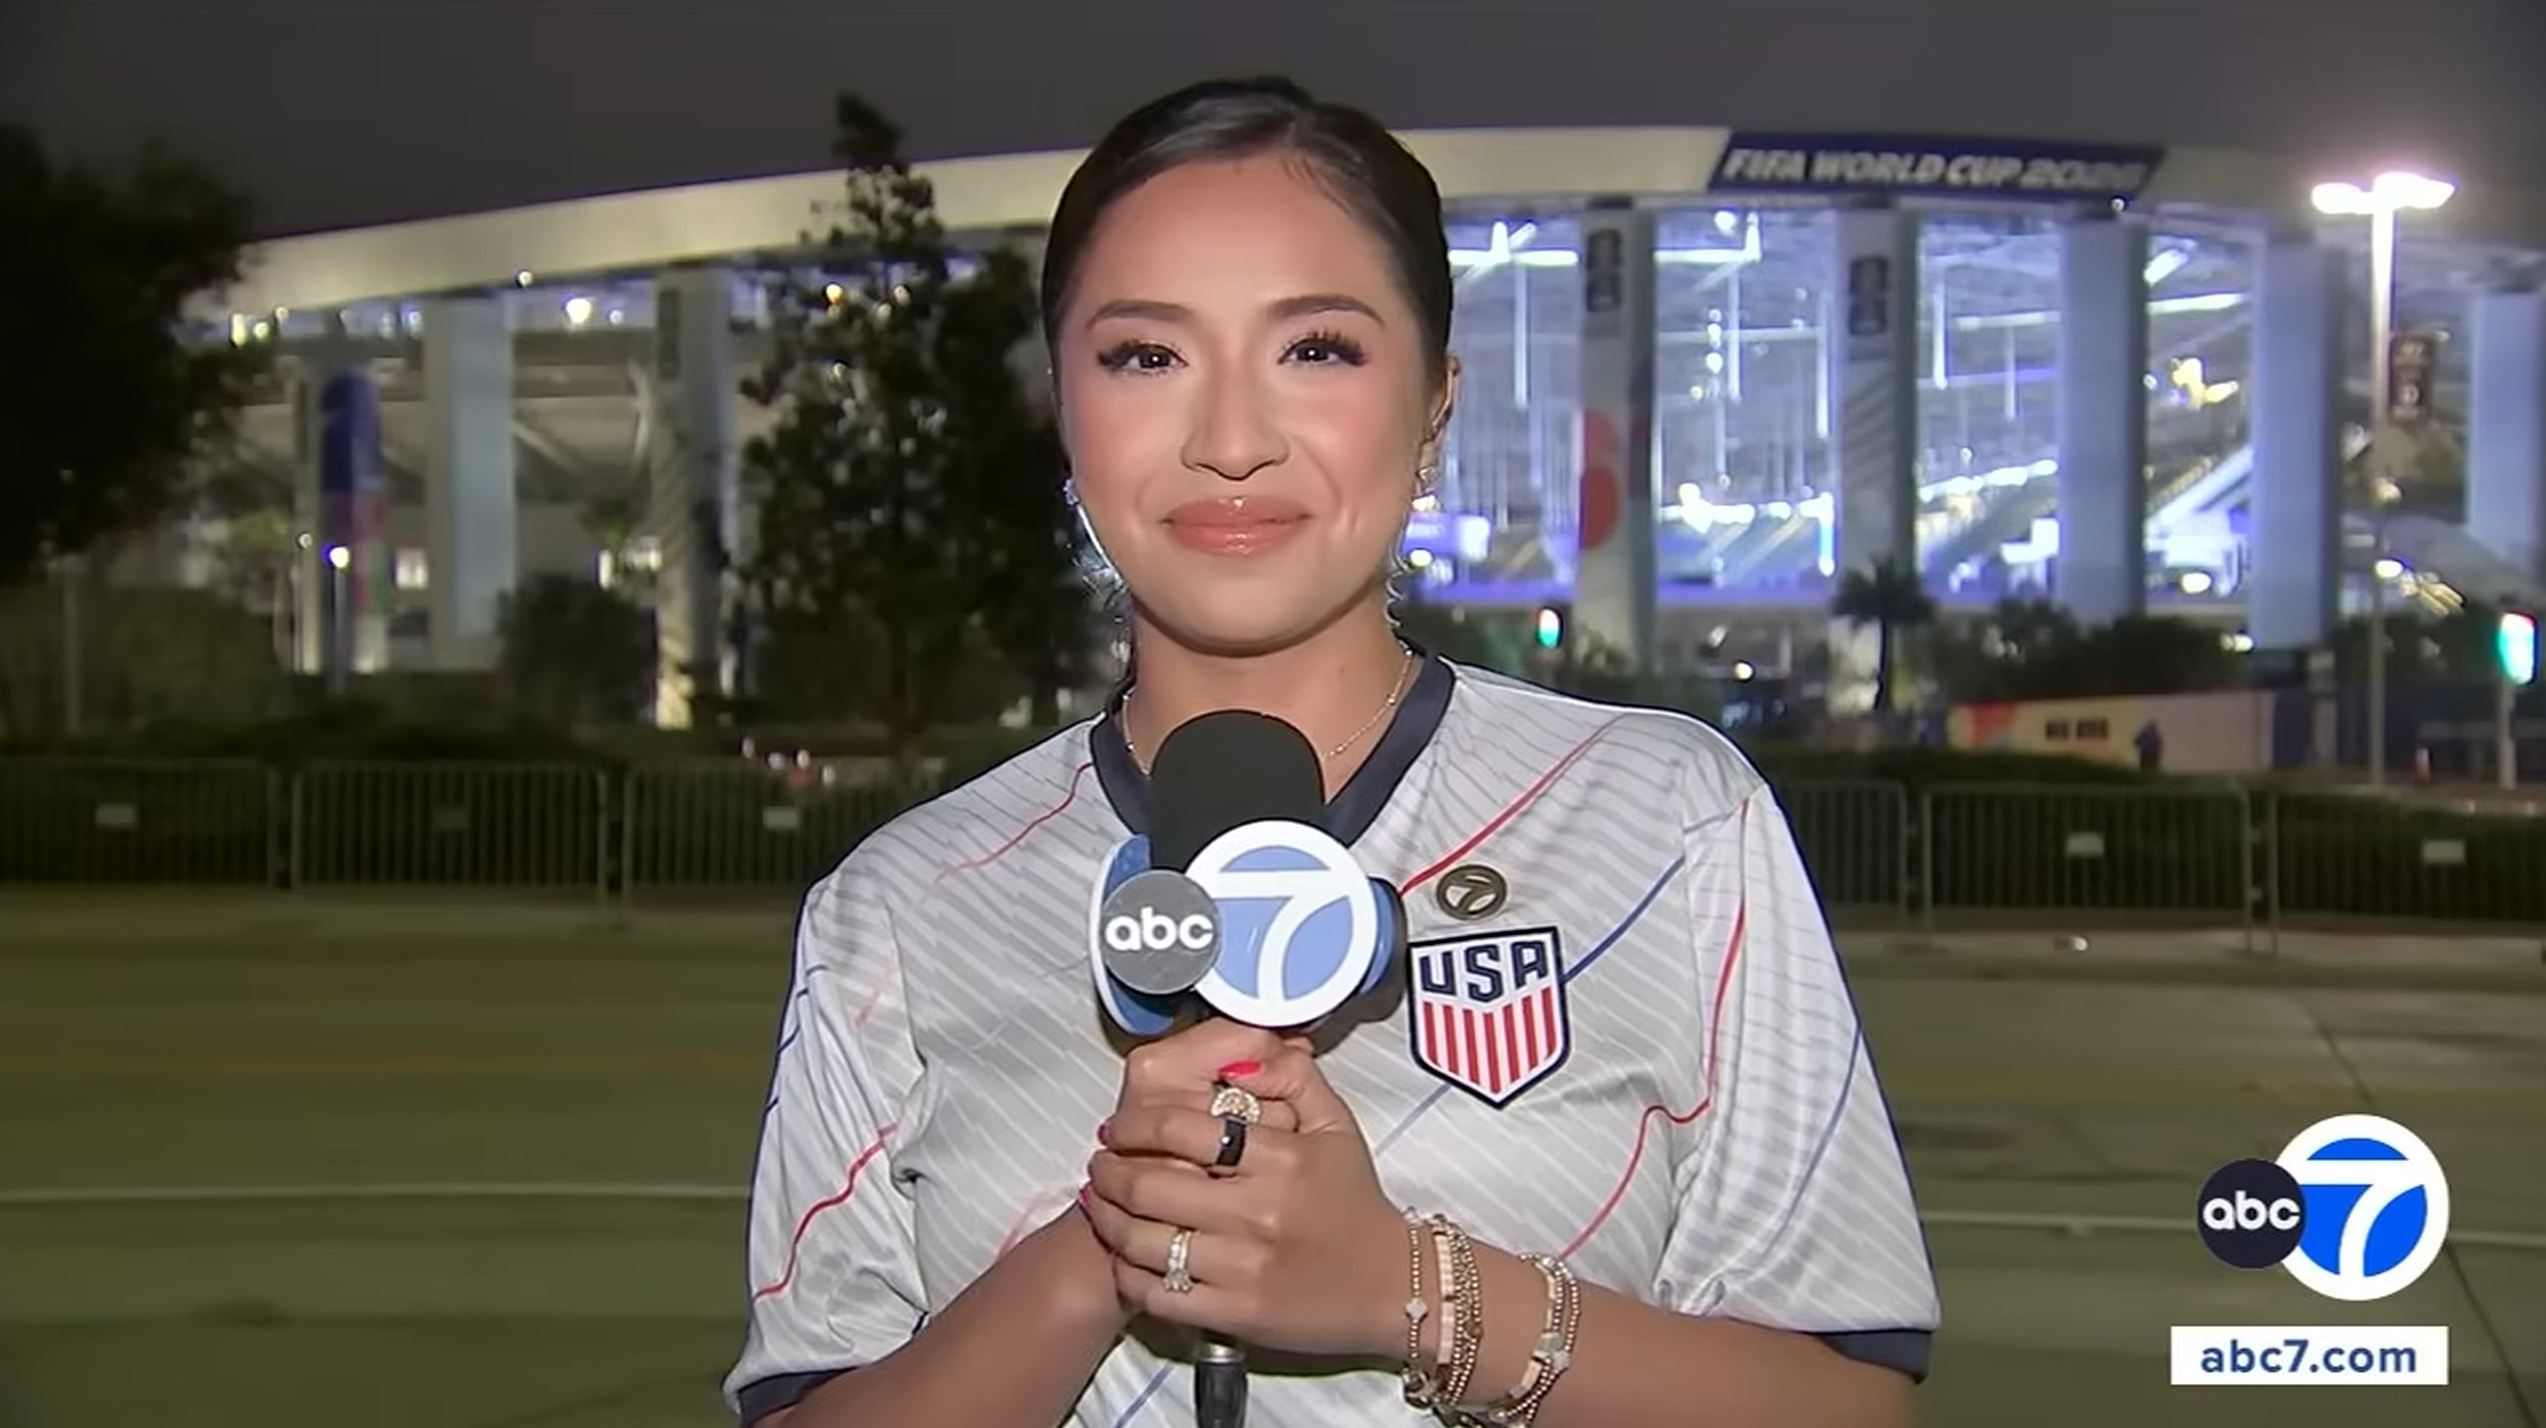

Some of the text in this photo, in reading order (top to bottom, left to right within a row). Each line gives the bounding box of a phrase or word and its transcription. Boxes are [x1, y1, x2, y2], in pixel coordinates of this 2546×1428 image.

[1721, 148, 1807, 181] FIFA
[1810, 150, 1947, 185] WORLD
[1944, 154, 2024, 189] CUP
[1105, 906, 1215, 952] abc
[1419, 940, 1549, 1003] USA
